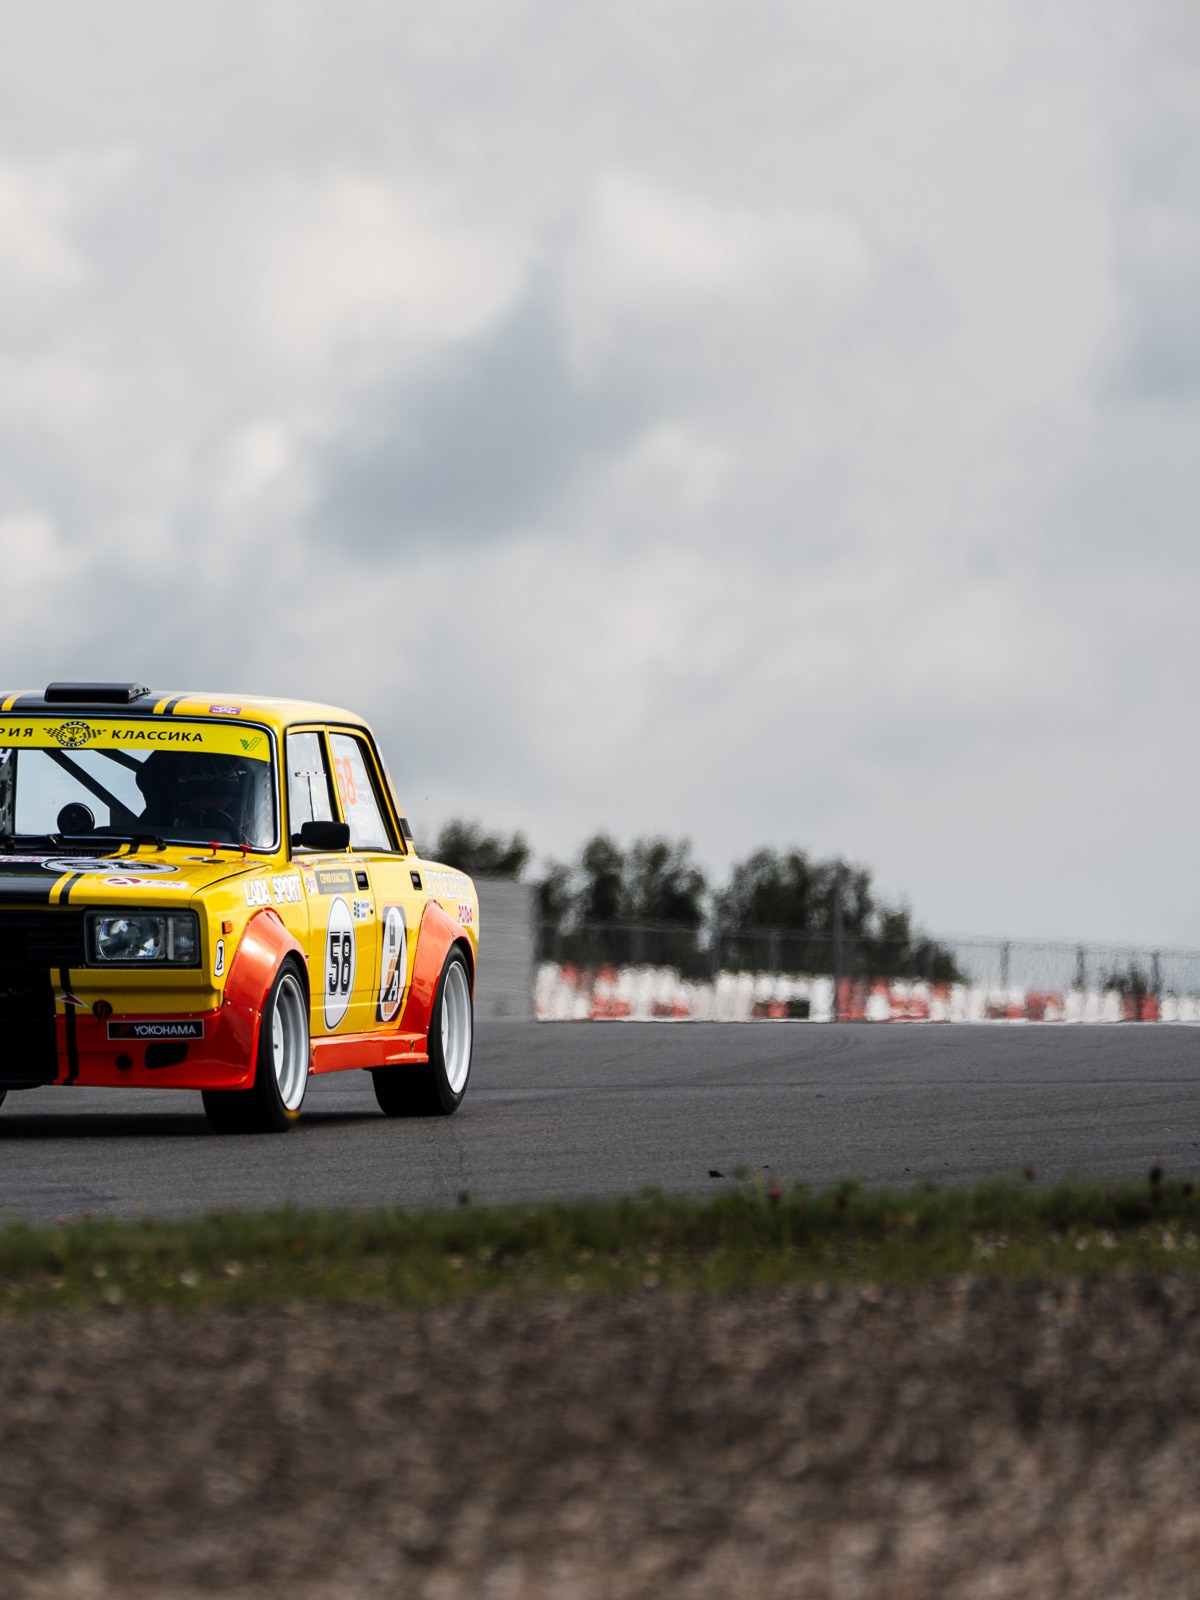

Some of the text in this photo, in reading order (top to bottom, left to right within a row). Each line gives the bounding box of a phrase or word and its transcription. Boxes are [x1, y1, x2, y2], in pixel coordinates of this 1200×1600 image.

[111, 729, 204, 743] КЛАССИКА
[334, 757, 357, 806] 58
[242, 873, 303, 908] LADA SPORT
[328, 931, 351, 996] 58
[133, 1025, 197, 1037] YOKOHAMA
